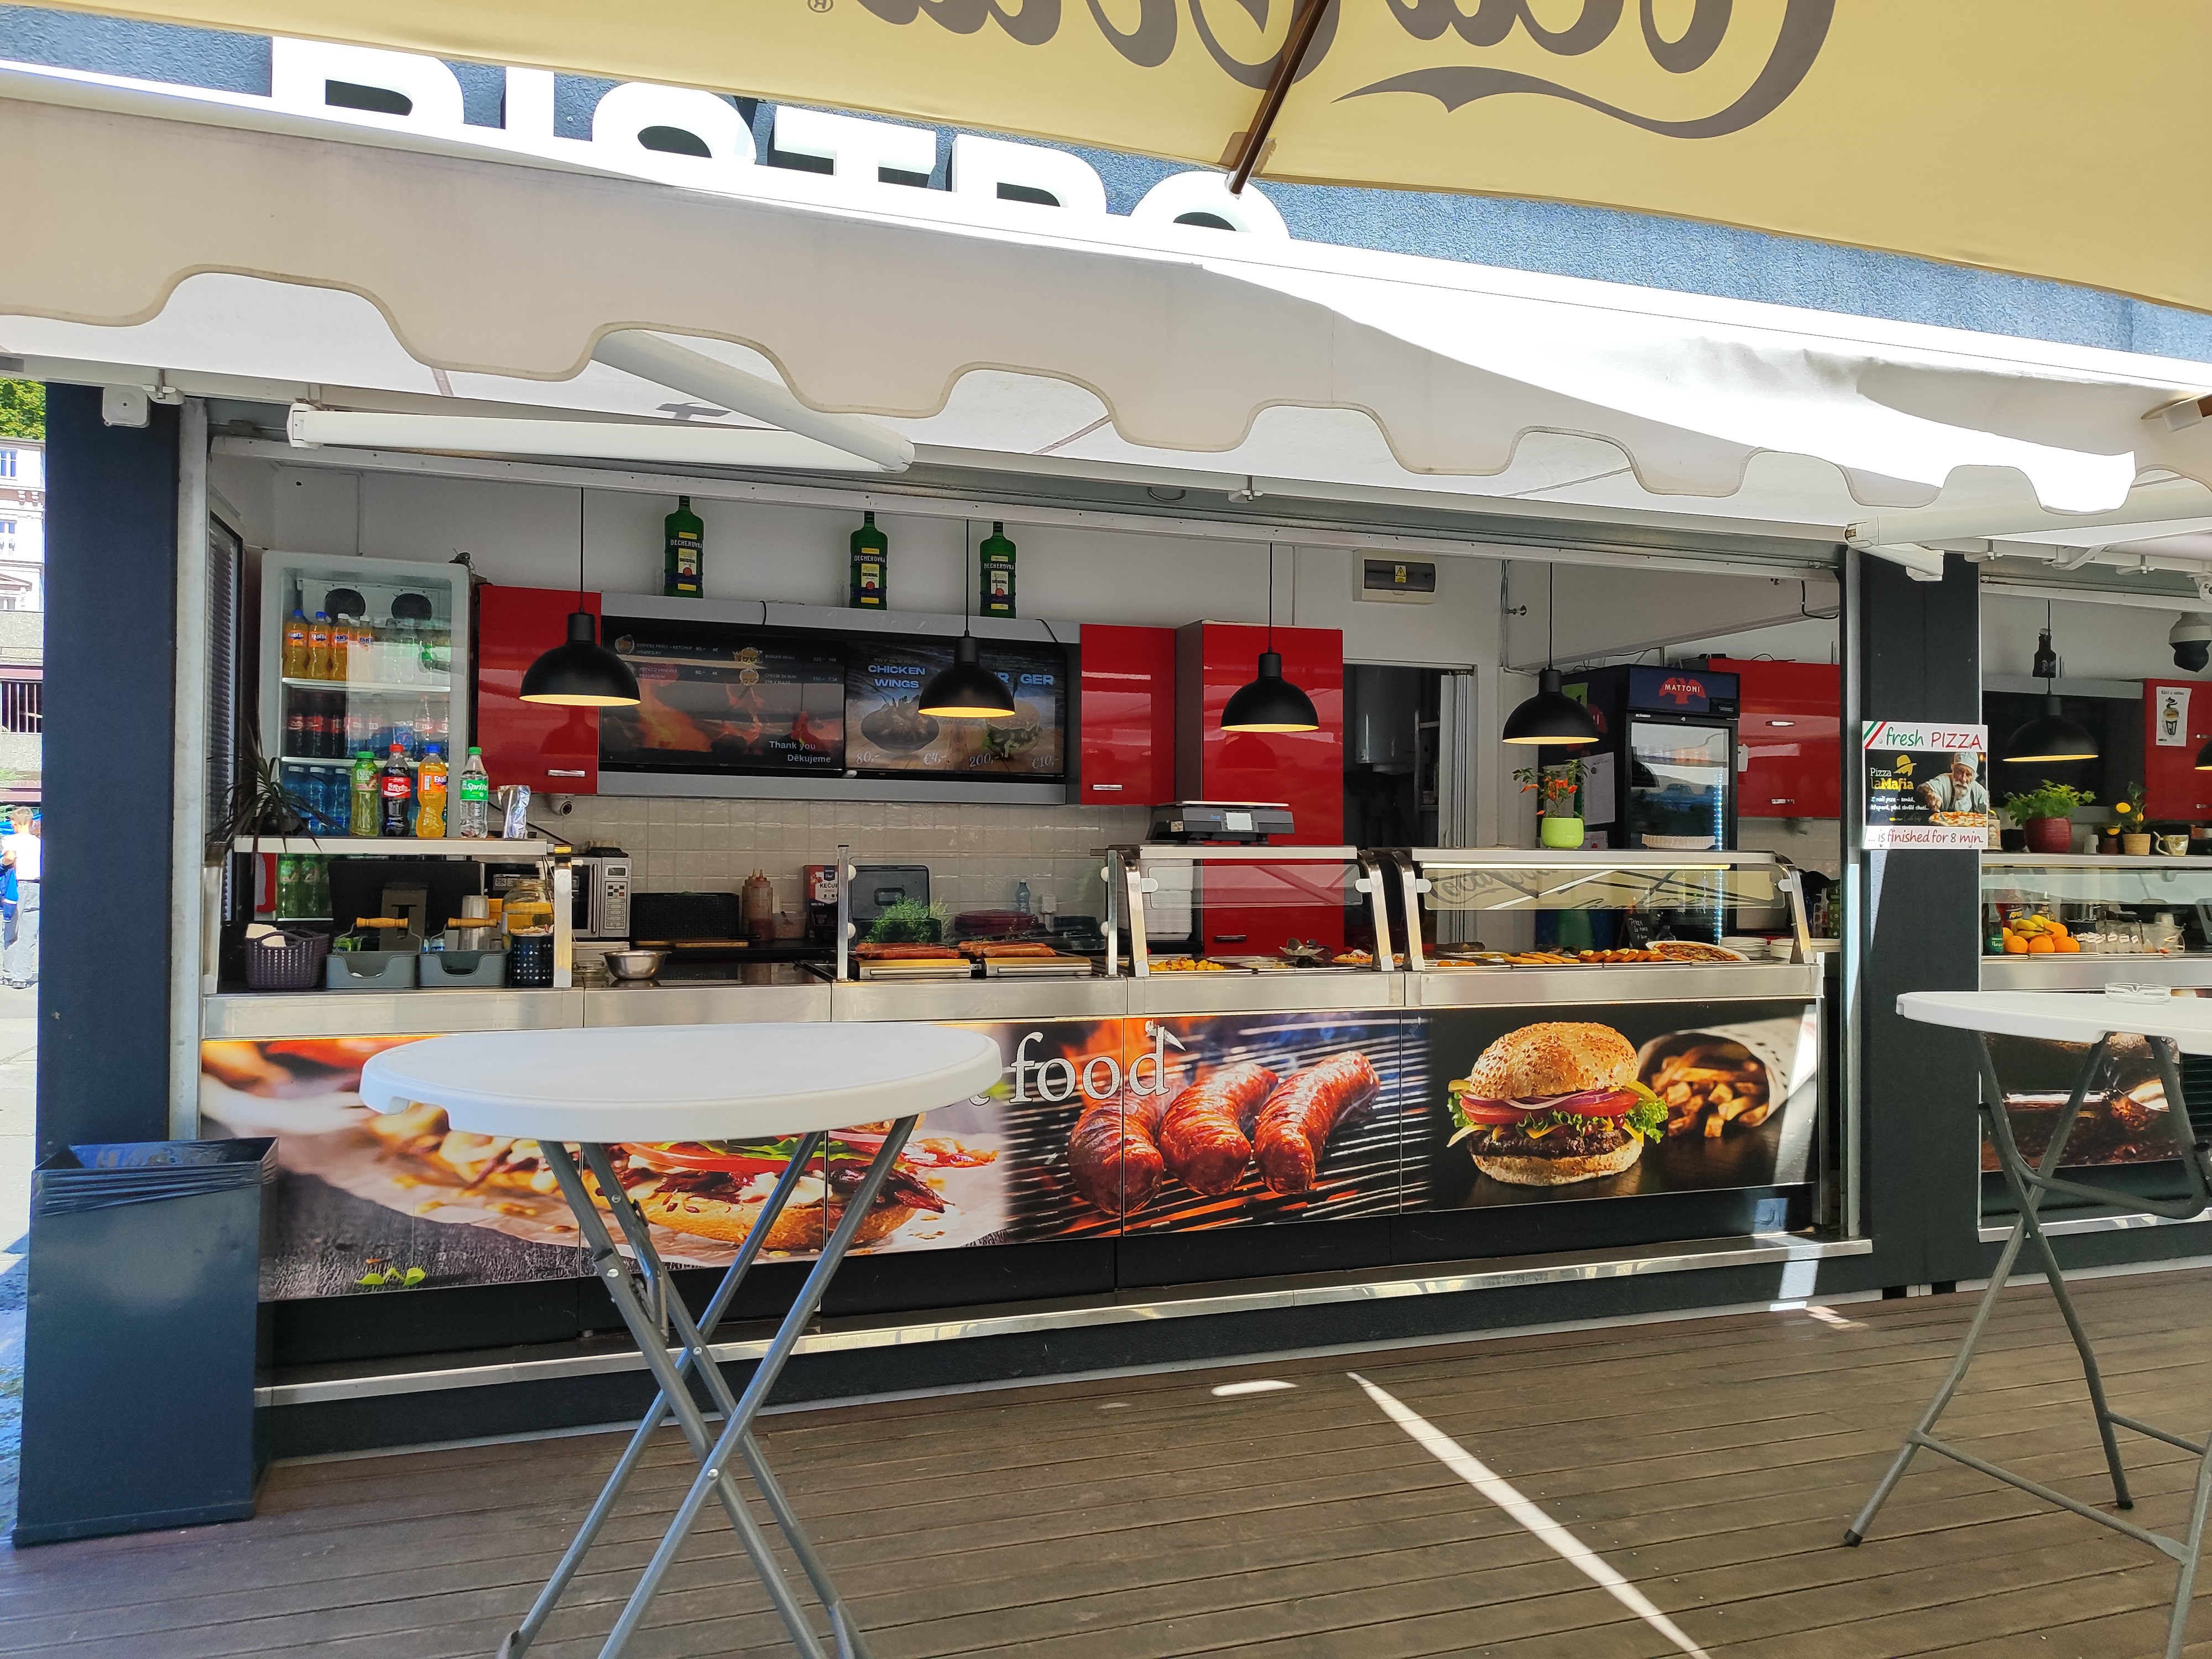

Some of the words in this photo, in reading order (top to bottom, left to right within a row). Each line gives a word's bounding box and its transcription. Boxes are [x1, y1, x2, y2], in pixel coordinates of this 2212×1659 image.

[854, 555, 886, 563] BECHEROVKA
[868, 665, 926, 675] CHICKEN
[874, 679, 919, 688] WINGS
[1665, 684, 1700, 693] MATTONI
[1886, 727, 1924, 747] fresh
[1931, 732, 1983, 750] PIZZA
[769, 740, 797, 750] Thank
[800, 743, 816, 751] you
[787, 754, 831, 764] Děkujeme
[1870, 767, 1892, 777] Pizza
[1888, 829, 1930, 842] finished
[1932, 830, 1949, 843] for
[1951, 833, 1957, 843] 8
[1009, 1025, 1170, 1103] food
